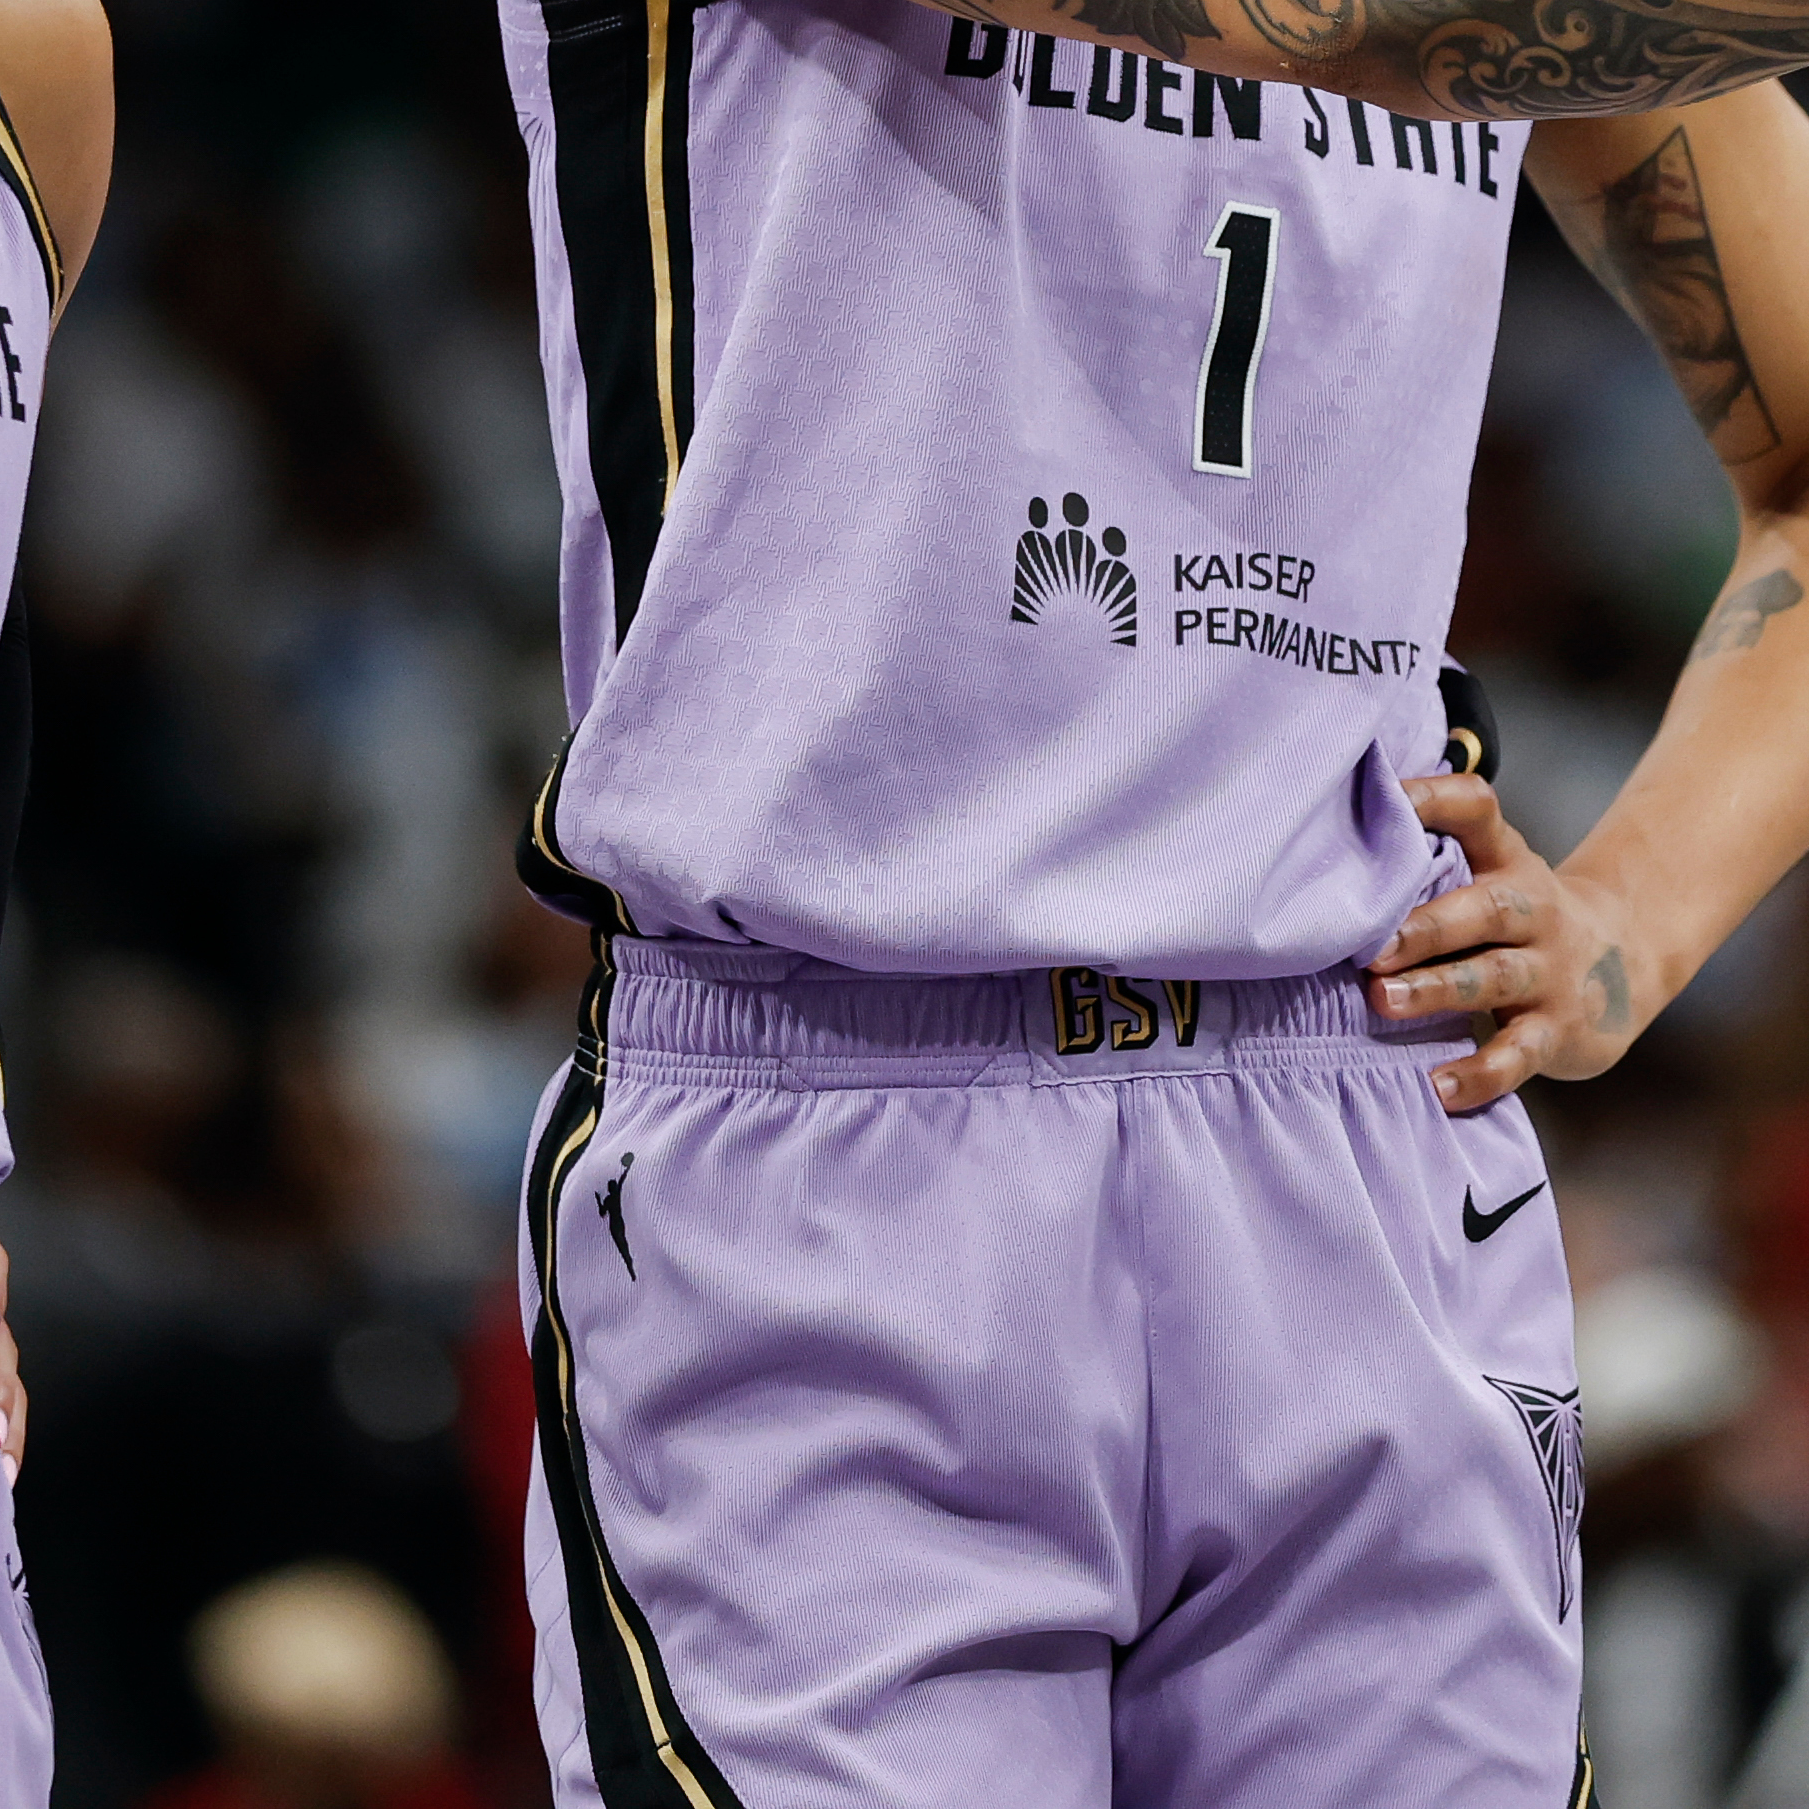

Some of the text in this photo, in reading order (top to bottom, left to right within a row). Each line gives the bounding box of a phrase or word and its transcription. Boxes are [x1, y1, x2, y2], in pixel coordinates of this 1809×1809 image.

[1193, 200, 1281, 479] 1
[1175, 553, 1315, 603] KAISER
[1049, 966, 1200, 1055] GSV
